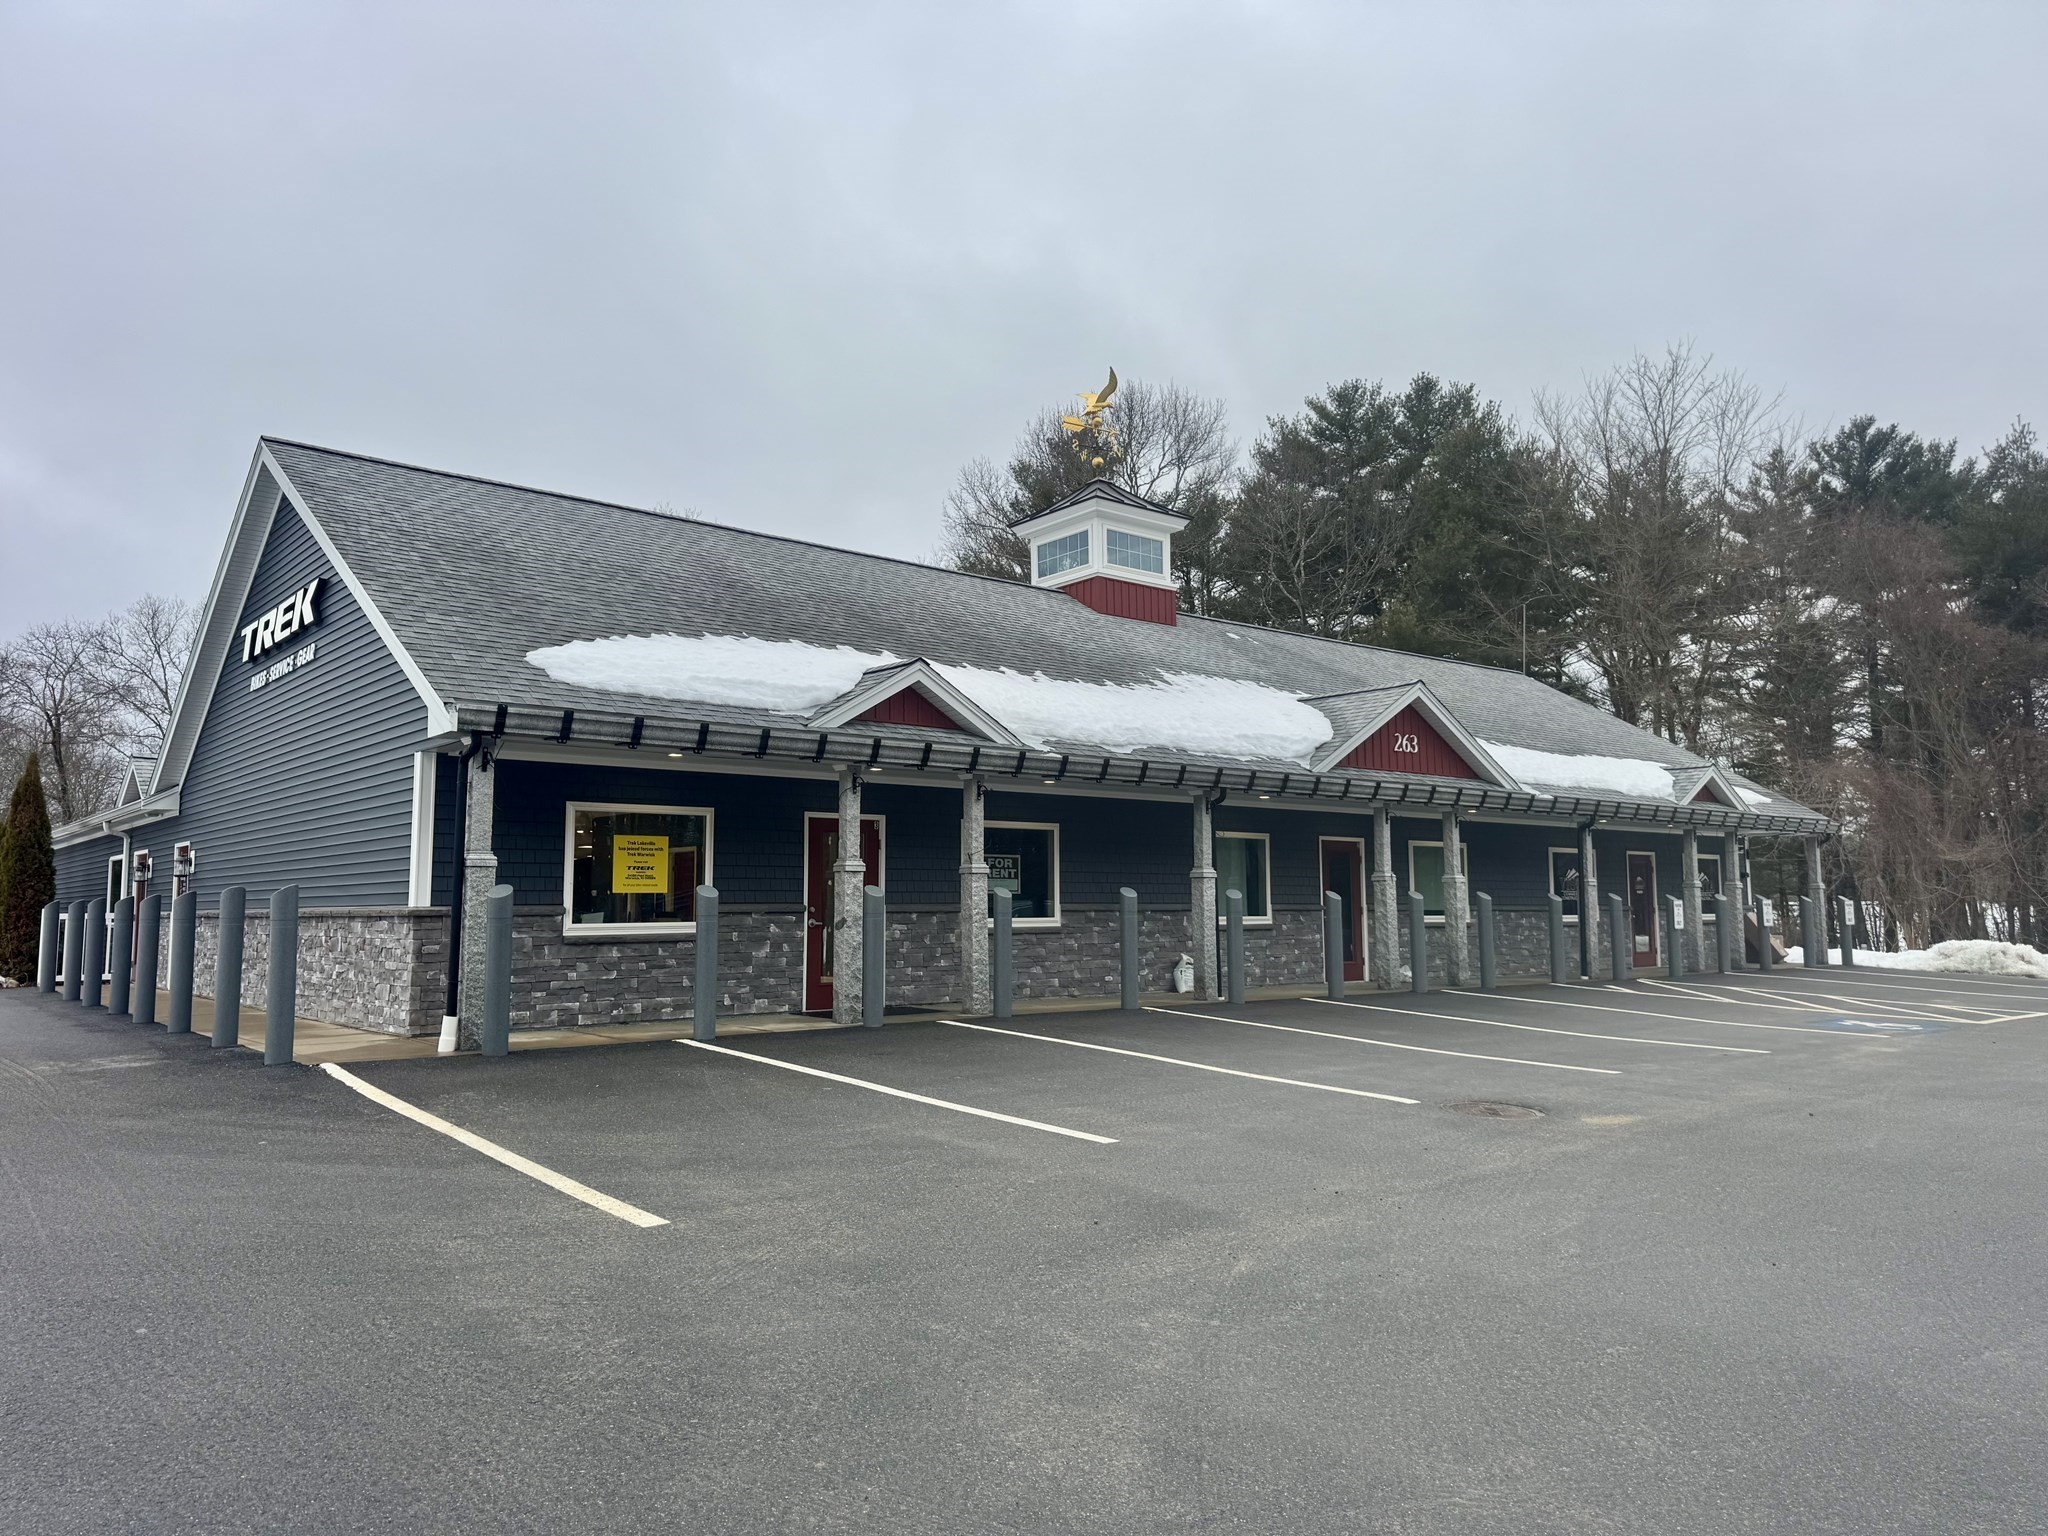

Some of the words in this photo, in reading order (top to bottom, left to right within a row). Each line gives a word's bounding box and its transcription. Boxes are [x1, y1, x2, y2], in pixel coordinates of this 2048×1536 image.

[241, 578, 320, 663] TREK
[250, 673, 267, 692] BIKES
[268, 654, 295, 683] SERVICE
[296, 643, 316, 667] GEAR
[1393, 732, 1419, 754] 263
[988, 858, 1013, 868] FOR
